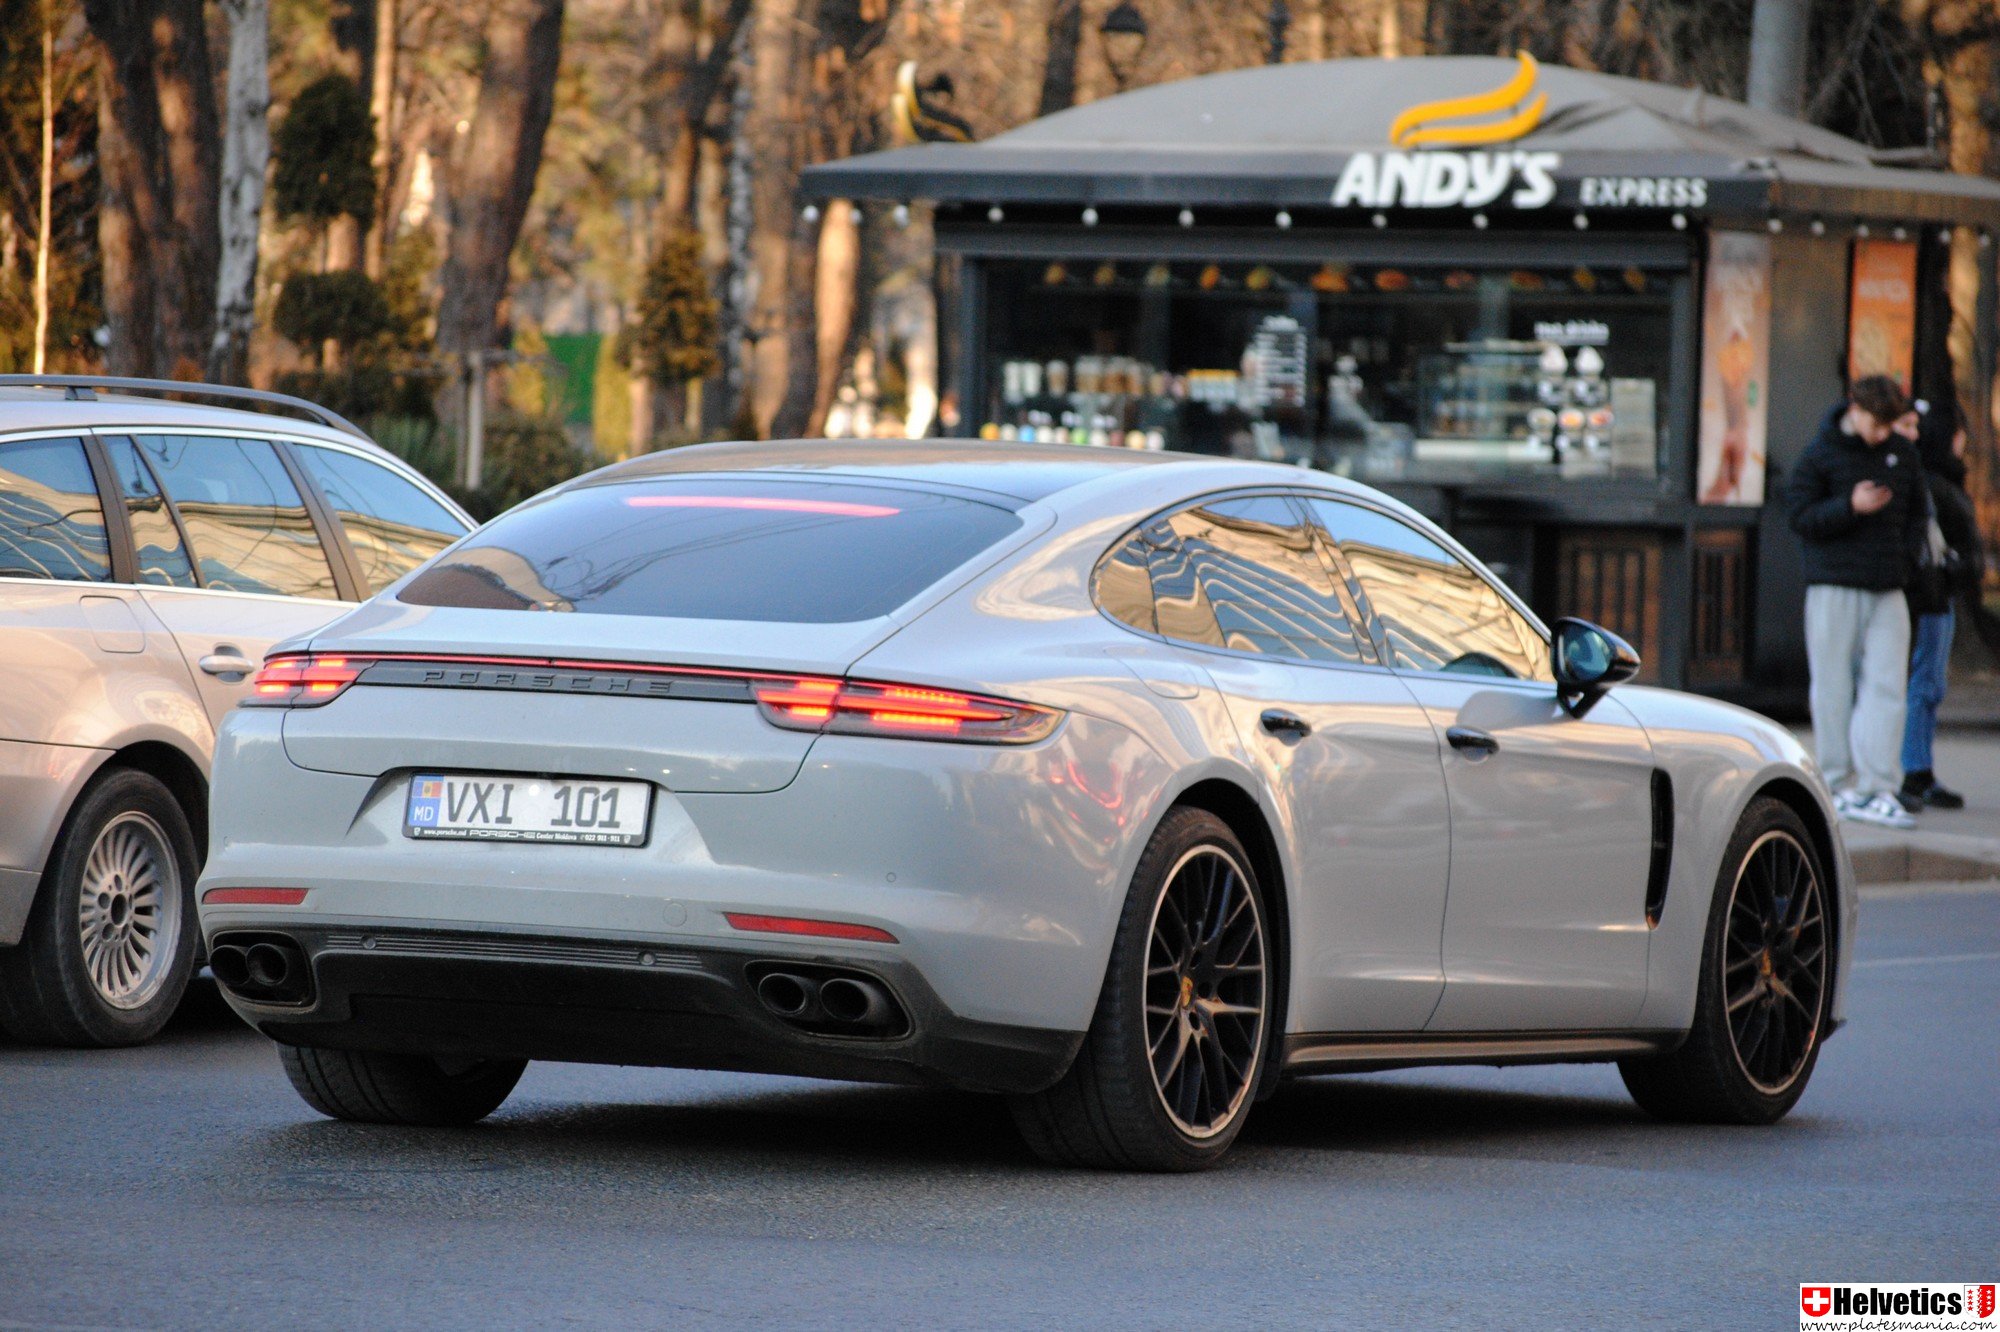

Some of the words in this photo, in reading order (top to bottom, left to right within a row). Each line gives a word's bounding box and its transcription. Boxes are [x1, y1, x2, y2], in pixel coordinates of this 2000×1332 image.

[1330, 150, 1560, 210] ANDY'S
[1579, 177, 1708, 208] EXPRESS
[423, 670, 673, 693] PORSCHE
[413, 806, 434, 822] MD
[447, 782, 515, 824] VXI
[550, 785, 622, 829] 101
[469, 829, 536, 839] PORSCHE
